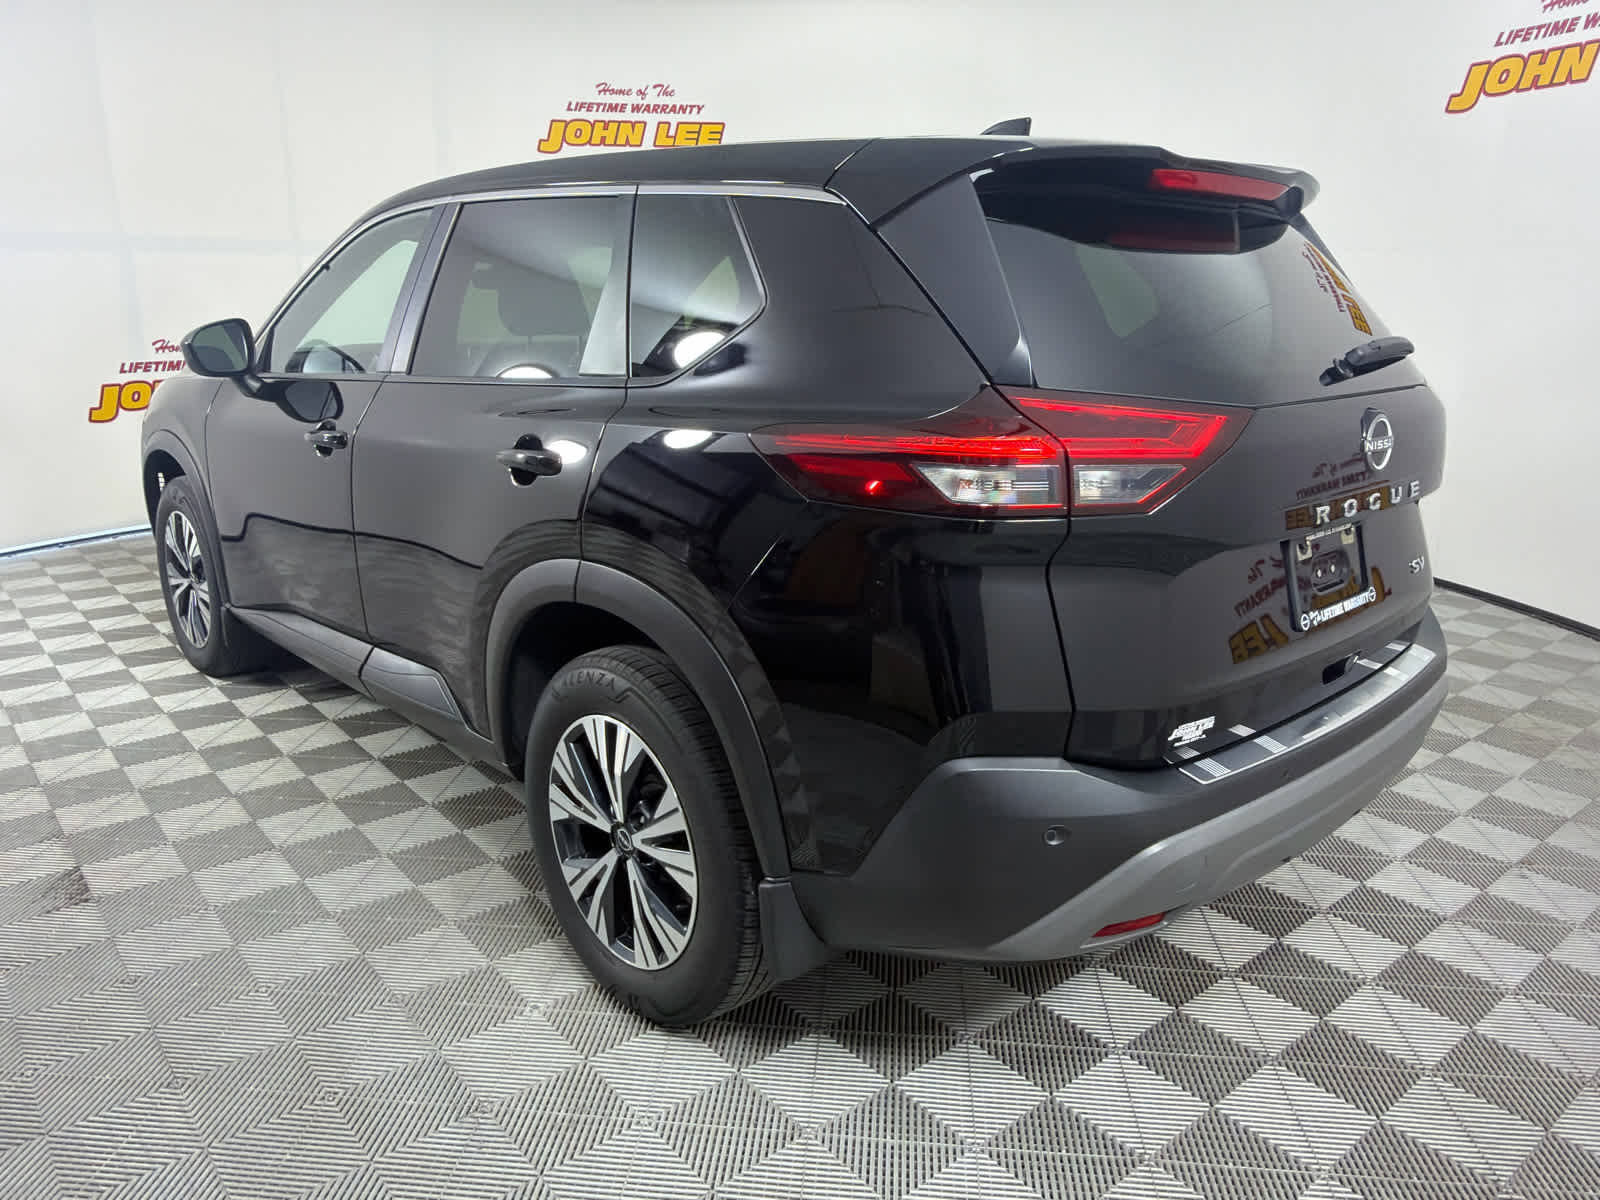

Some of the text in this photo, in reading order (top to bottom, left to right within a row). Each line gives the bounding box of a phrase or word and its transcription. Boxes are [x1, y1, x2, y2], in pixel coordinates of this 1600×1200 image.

[1494, 15, 1581, 47] LIFETIME
[596, 83, 676, 100] Home of The
[1445, 38, 1600, 114] JOHN
[566, 101, 705, 115] LIFETIME WARRANTY
[537, 119, 726, 154] JOHN LEE
[88, 379, 165, 423] JO
[1315, 480, 1421, 525] ROGUE
[1411, 555, 1425, 574] SV
